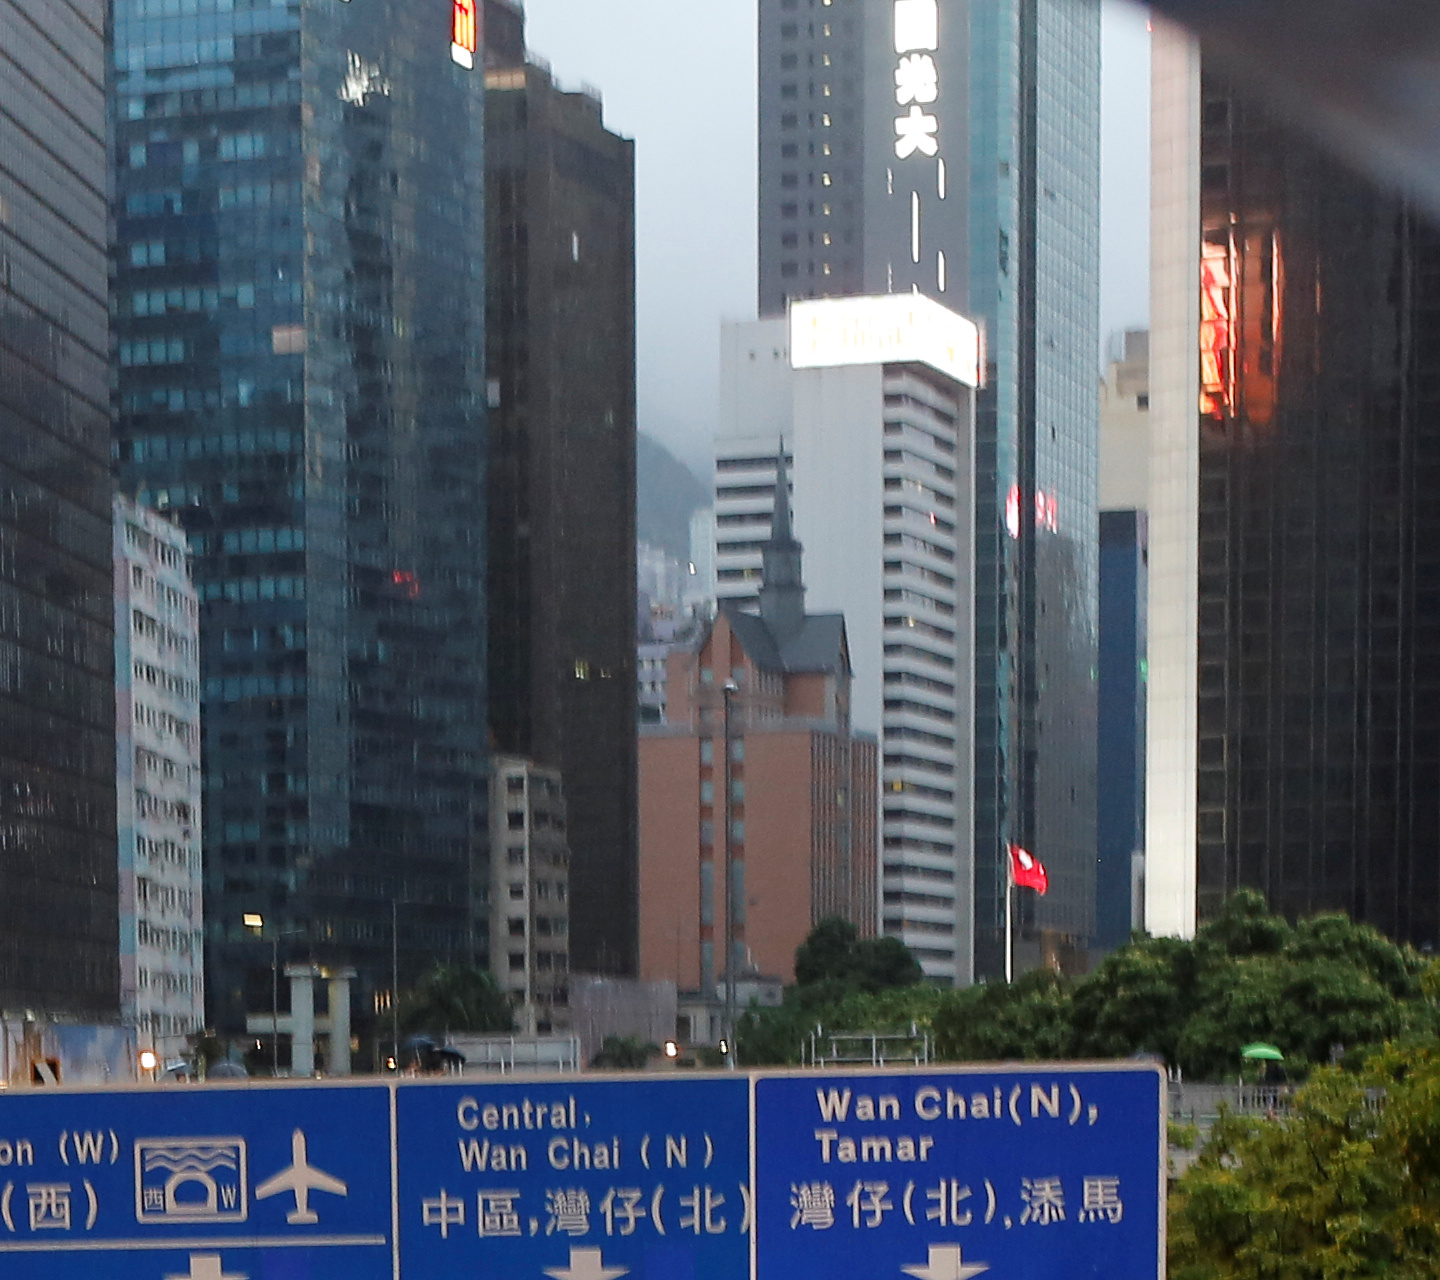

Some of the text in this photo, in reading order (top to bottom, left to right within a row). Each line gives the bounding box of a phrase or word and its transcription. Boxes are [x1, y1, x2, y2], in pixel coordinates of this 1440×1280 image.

[456, 1096, 593, 1131] Central,
[817, 1083, 1100, 1127] Wan Chai(N),
[60, 1129, 120, 1167] (W)
[458, 1139, 527, 1171] Wan
[547, 1138, 620, 1170] Chai
[815, 1130, 934, 1163] Tamar
[221, 1184, 237, 1209] W
